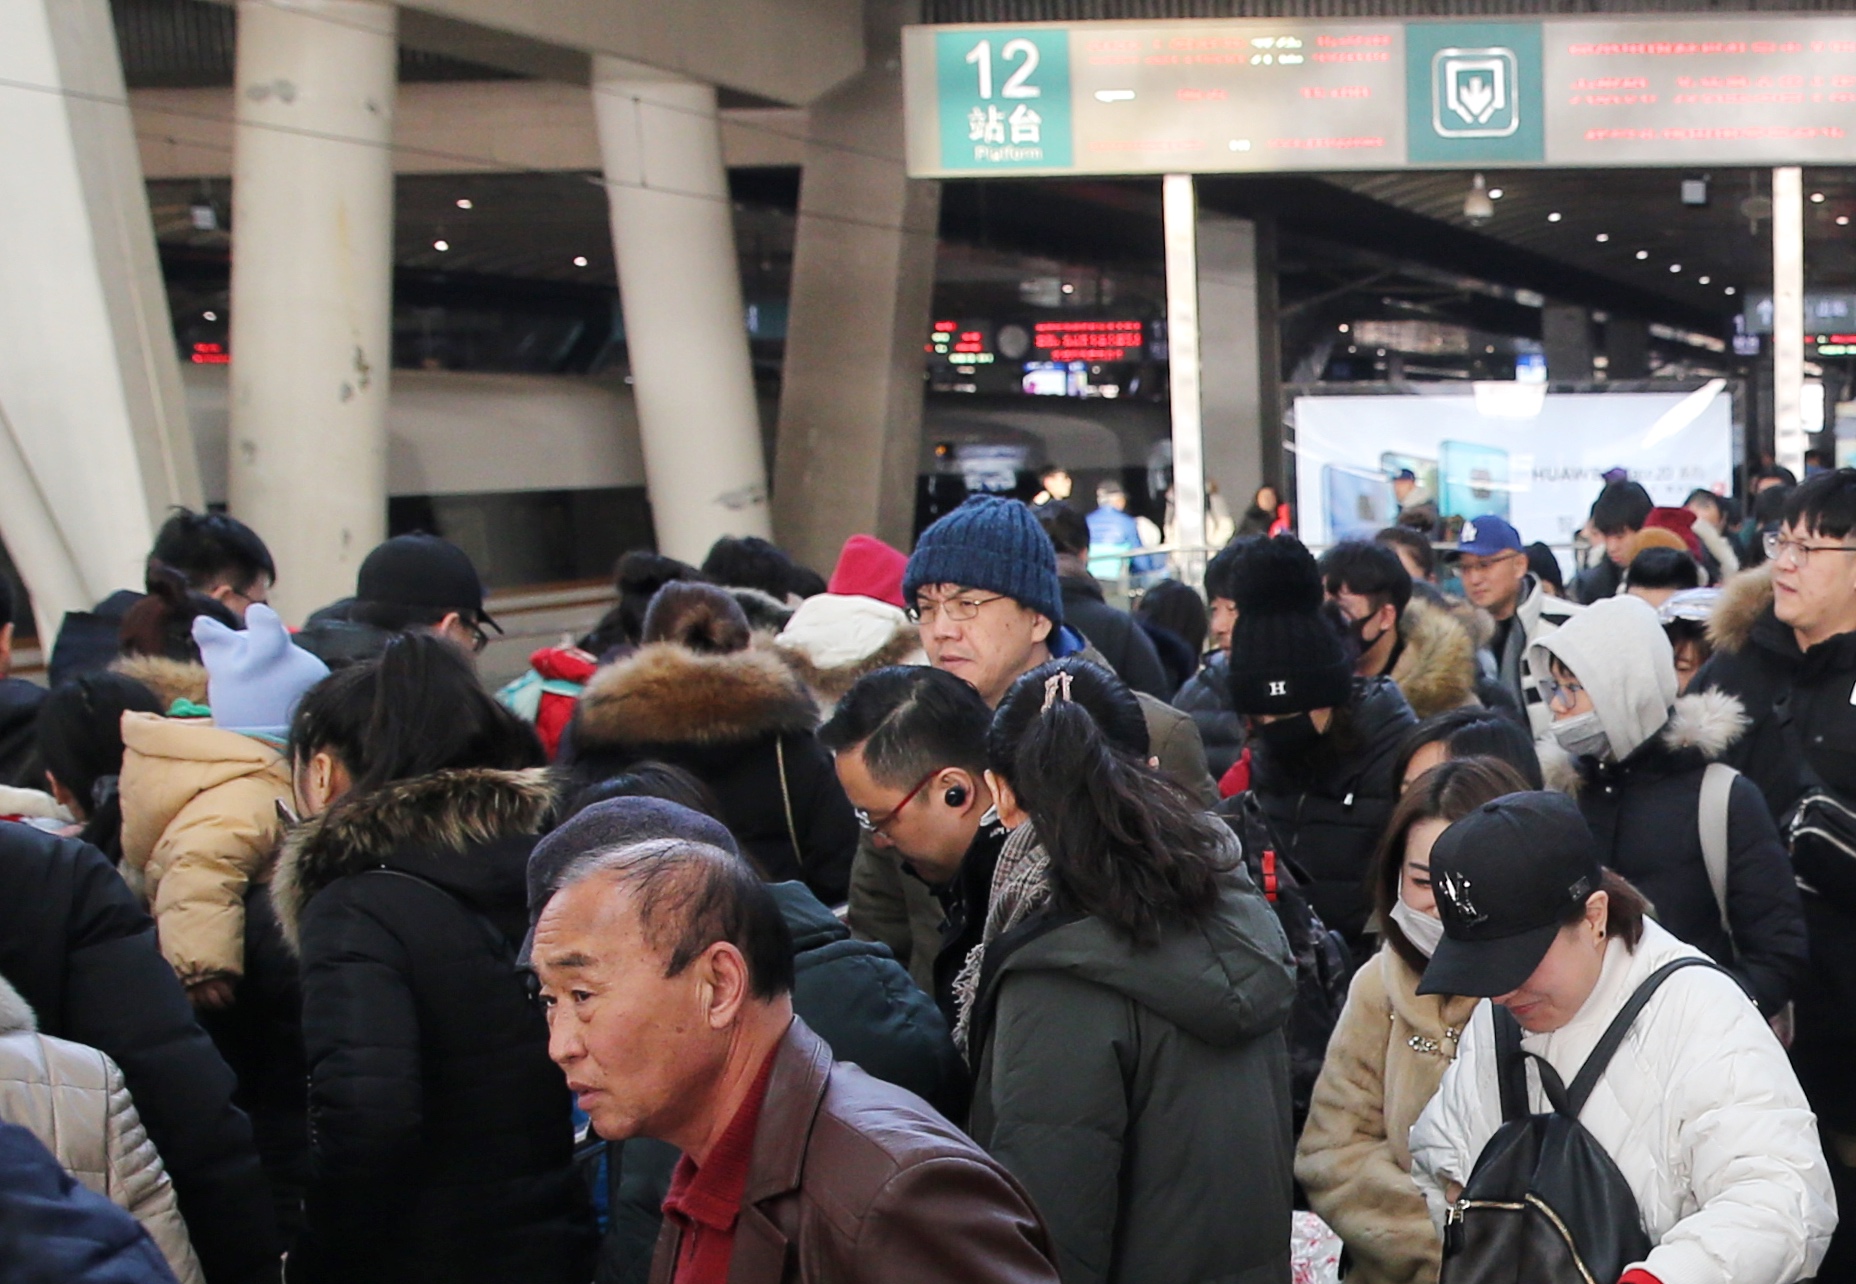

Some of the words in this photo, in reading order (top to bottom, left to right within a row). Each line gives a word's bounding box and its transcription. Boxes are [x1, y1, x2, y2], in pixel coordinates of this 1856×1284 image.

[965, 38, 1041, 99] 12
[967, 104, 1042, 144] 站台
[1532, 467, 1602, 481] HUAWE
[1269, 681, 1287, 696] H
